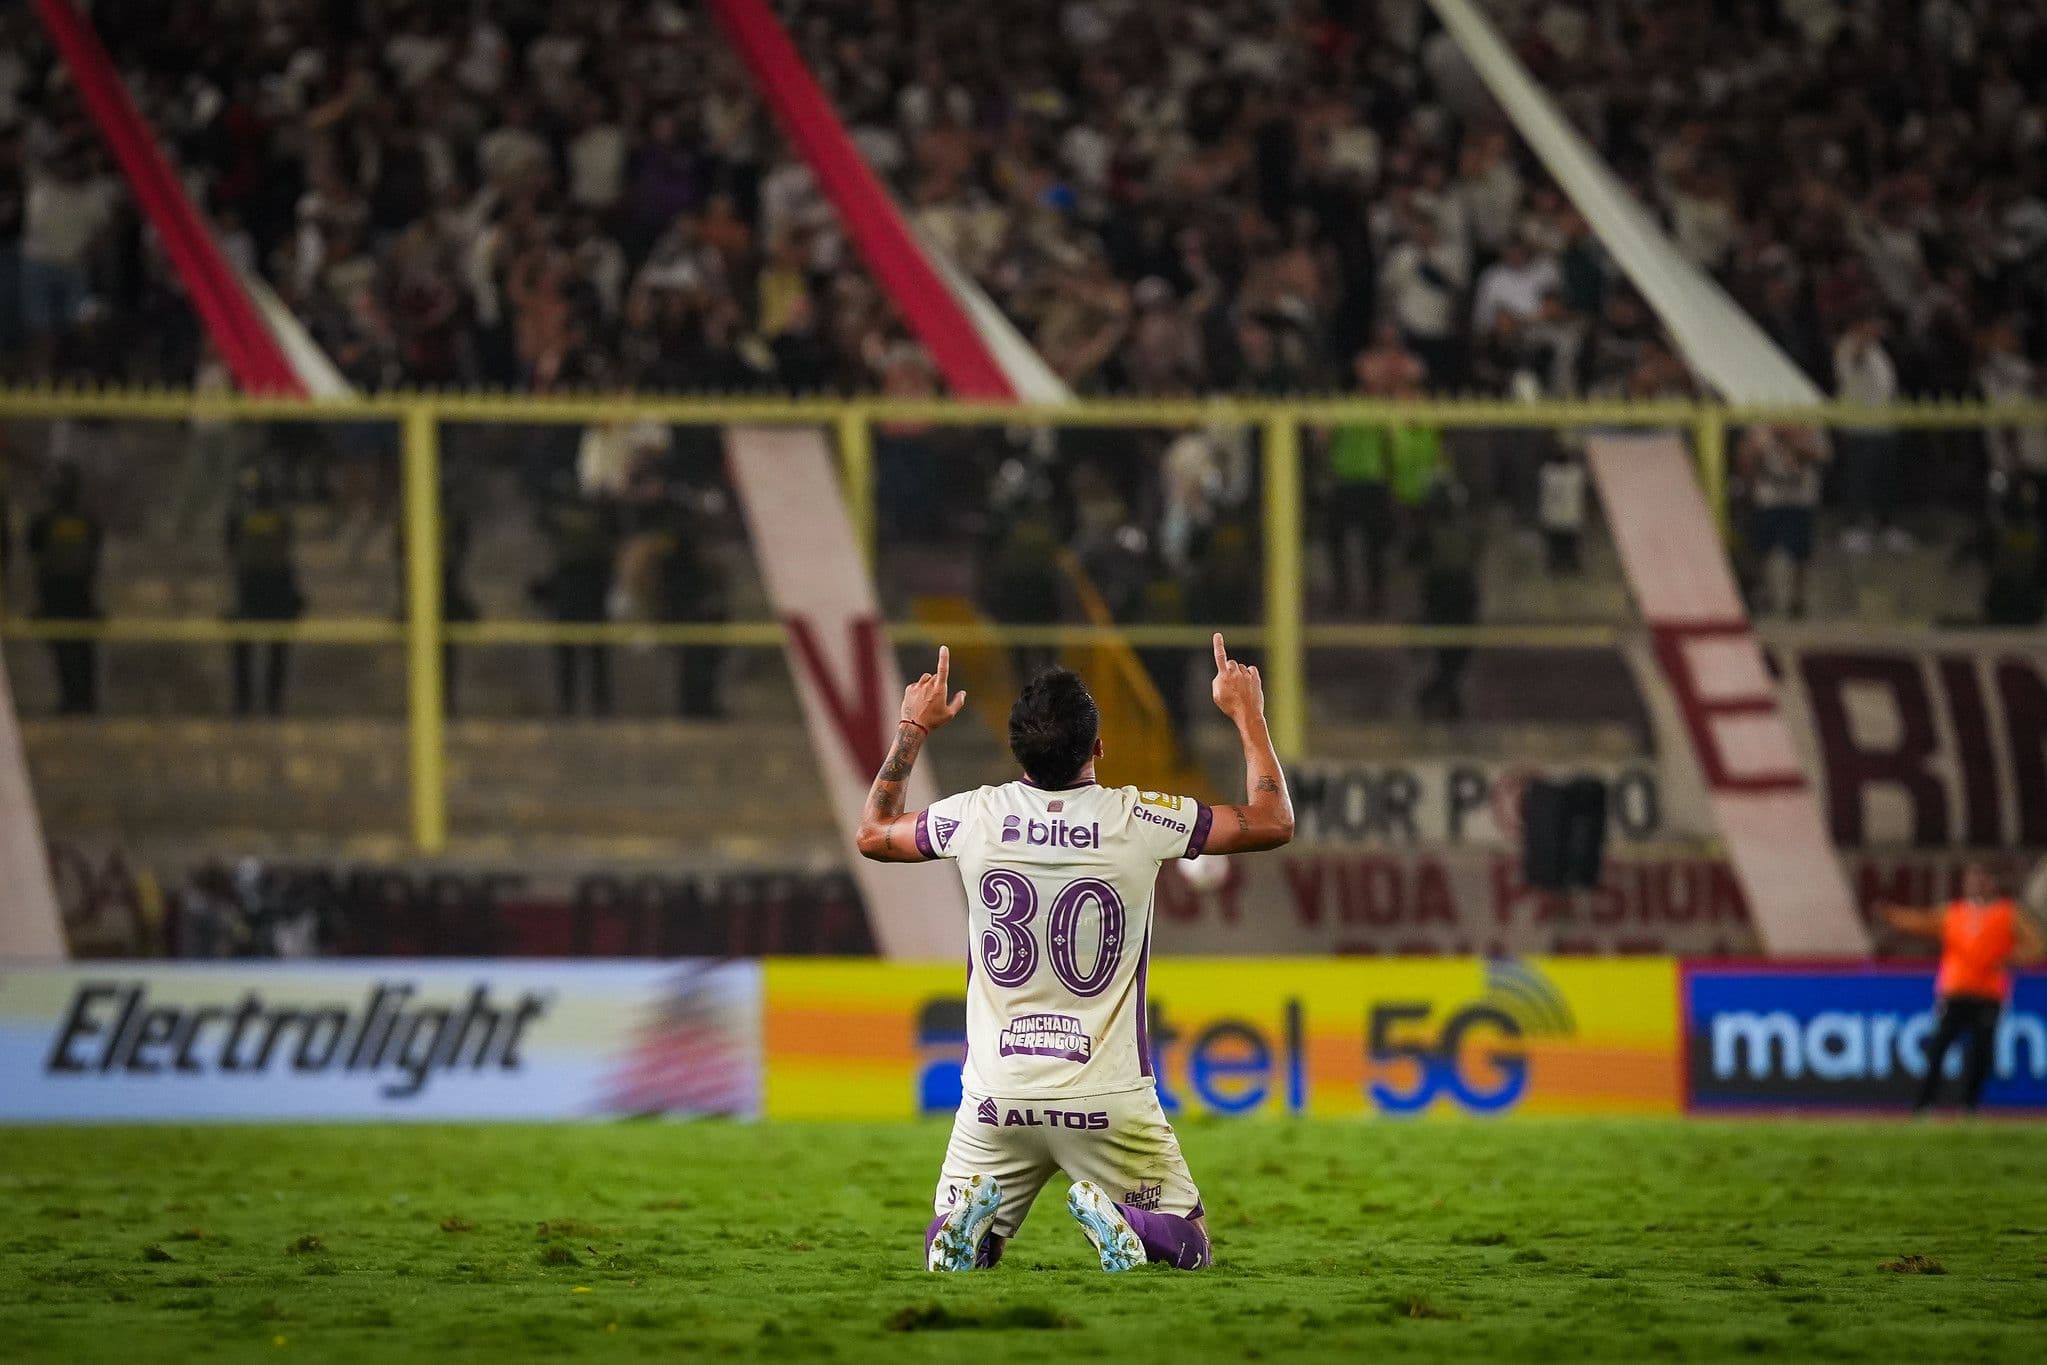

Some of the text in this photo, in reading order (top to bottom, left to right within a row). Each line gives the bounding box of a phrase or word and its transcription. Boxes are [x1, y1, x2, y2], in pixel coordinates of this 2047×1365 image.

[1133, 806, 1186, 833] Chema
[1027, 818, 1099, 849] bitel
[980, 869, 1126, 998] 30
[1012, 1016, 1080, 1034] HINCHADA
[47, 979, 550, 1100] Electrolight
[1001, 1031, 1090, 1057] MERENGUE
[1367, 1002, 1530, 1115] 5G
[1004, 1109, 1109, 1130] ALTOS
[1125, 1184, 1162, 1203] Electro
